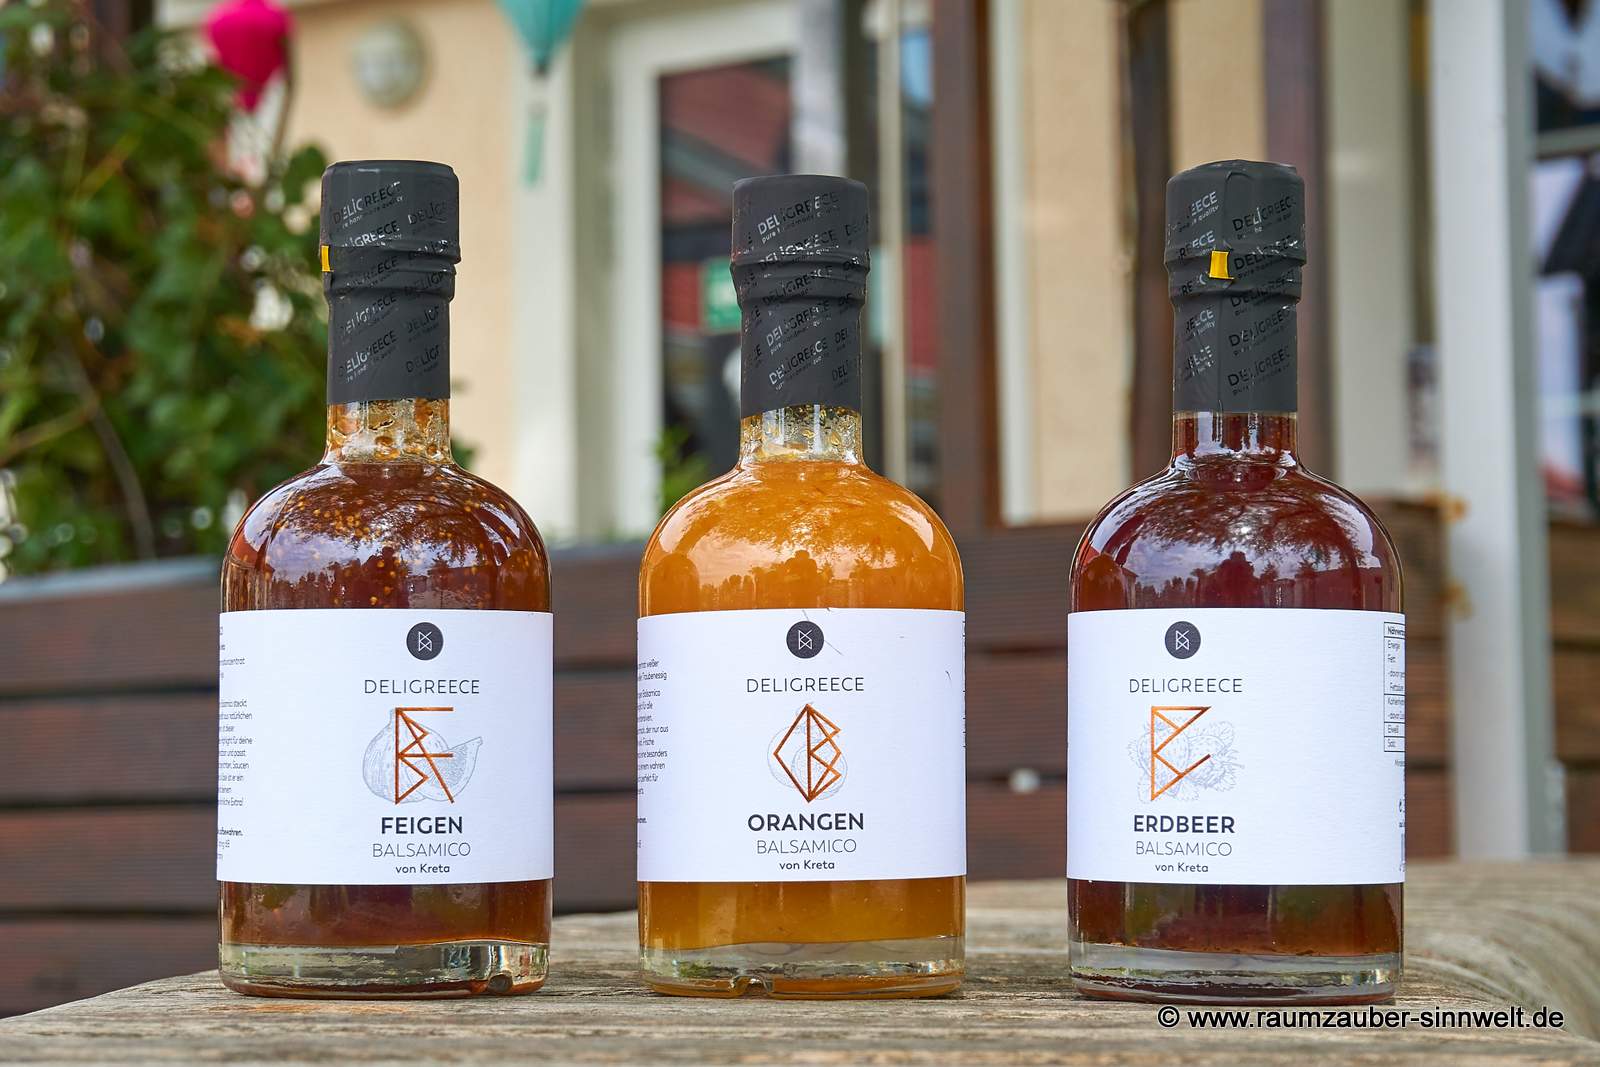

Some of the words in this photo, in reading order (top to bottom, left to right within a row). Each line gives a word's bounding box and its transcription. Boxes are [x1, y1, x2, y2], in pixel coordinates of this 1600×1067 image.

[365, 679, 480, 695] DELIGREECE
[747, 677, 865, 693] DELIGREECE
[1129, 678, 1243, 693] DELIGREECE
[381, 816, 463, 835] FEIGEN
[747, 812, 864, 832] ORANGEN
[1133, 814, 1235, 834] ERDBEER
[372, 841, 471, 858] BALSAMICO
[756, 838, 857, 855] BALSAMICO
[1135, 840, 1233, 857] BALSAMICO
[396, 866, 416, 874] von
[420, 863, 451, 874] Kreta
[780, 862, 800, 870] von
[804, 859, 835, 870] Kreta
[1155, 865, 1175, 873] von
[1178, 862, 1209, 873] Kreta
